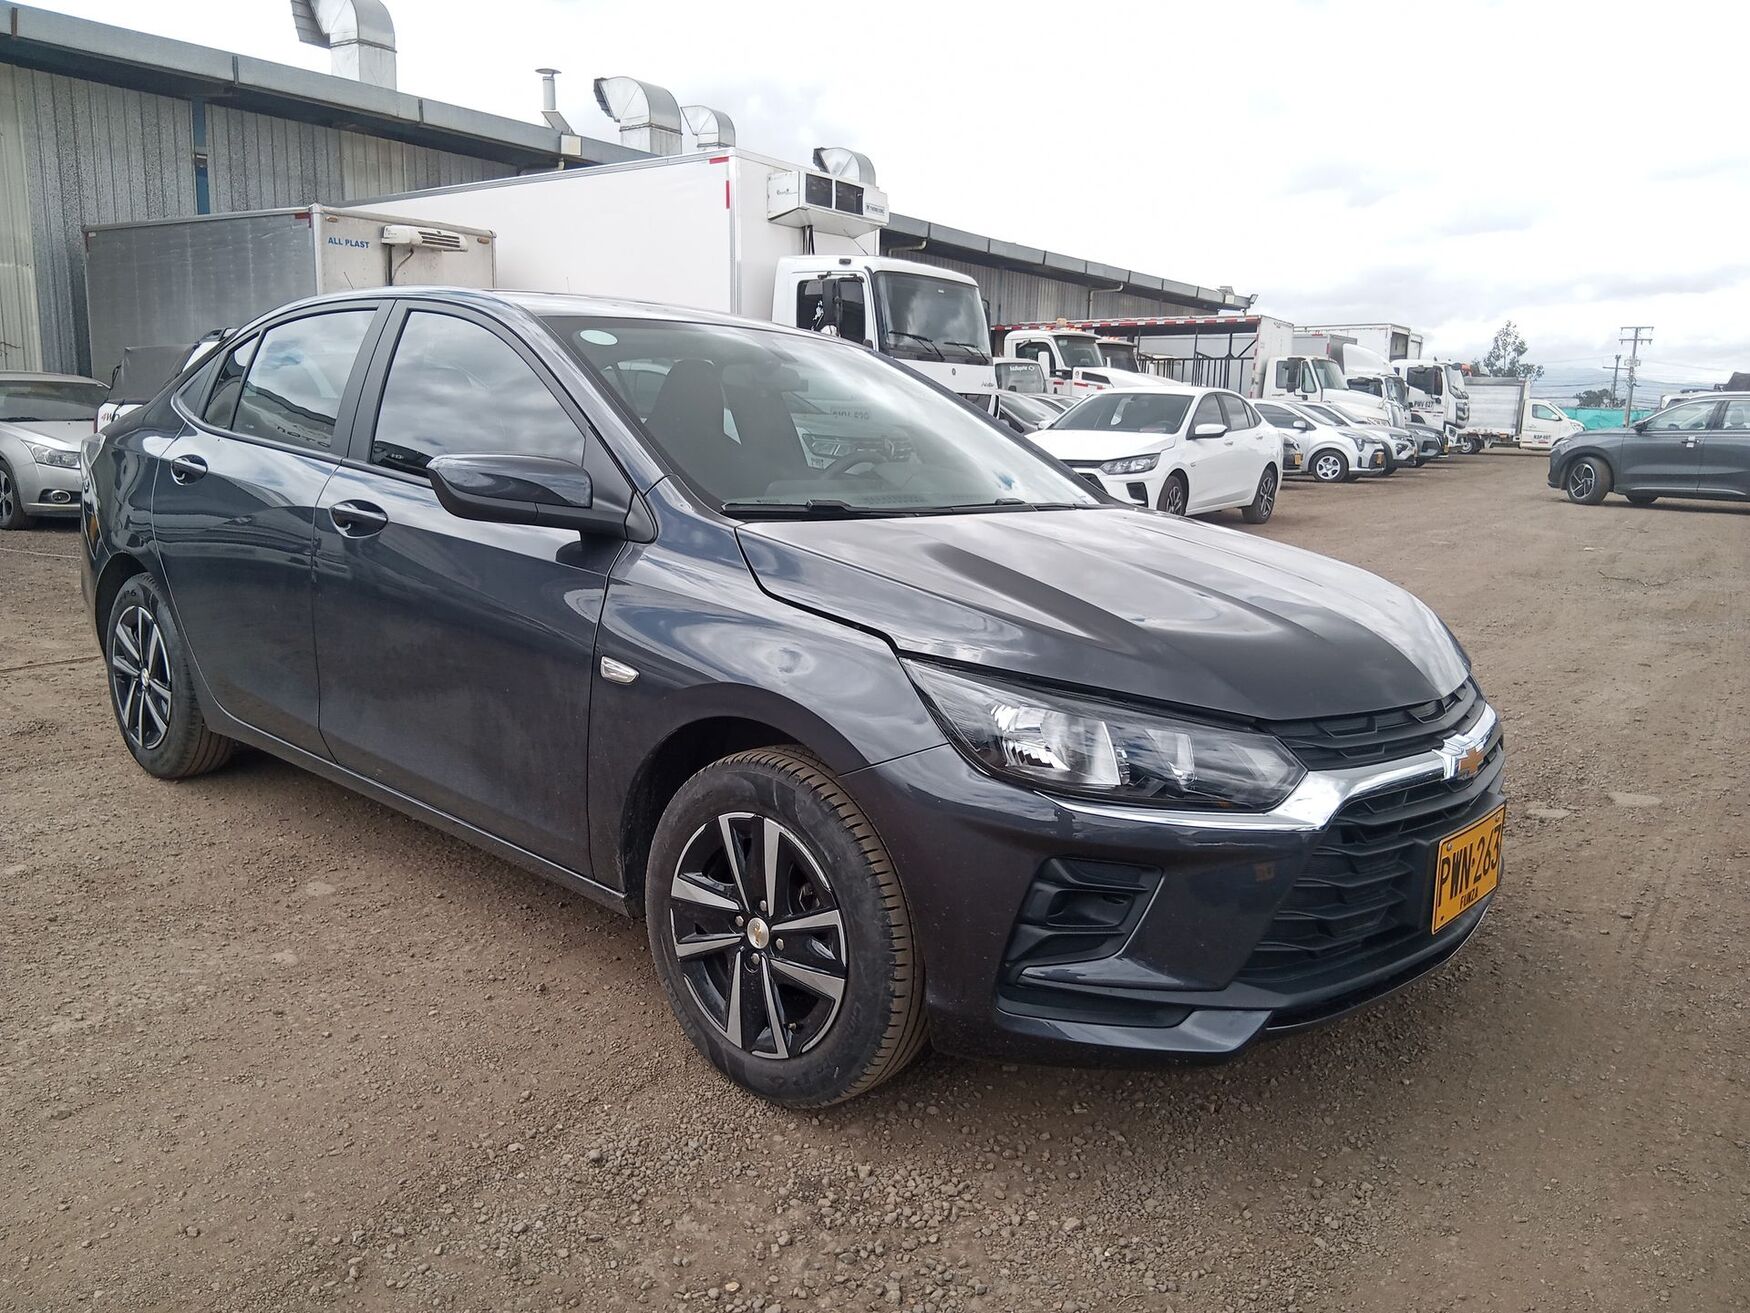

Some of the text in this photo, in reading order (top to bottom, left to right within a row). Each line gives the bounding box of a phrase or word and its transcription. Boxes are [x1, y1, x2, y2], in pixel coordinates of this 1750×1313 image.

[328, 236, 370, 249] ALL PLAST
[1459, 886, 1479, 910] FUNZA
